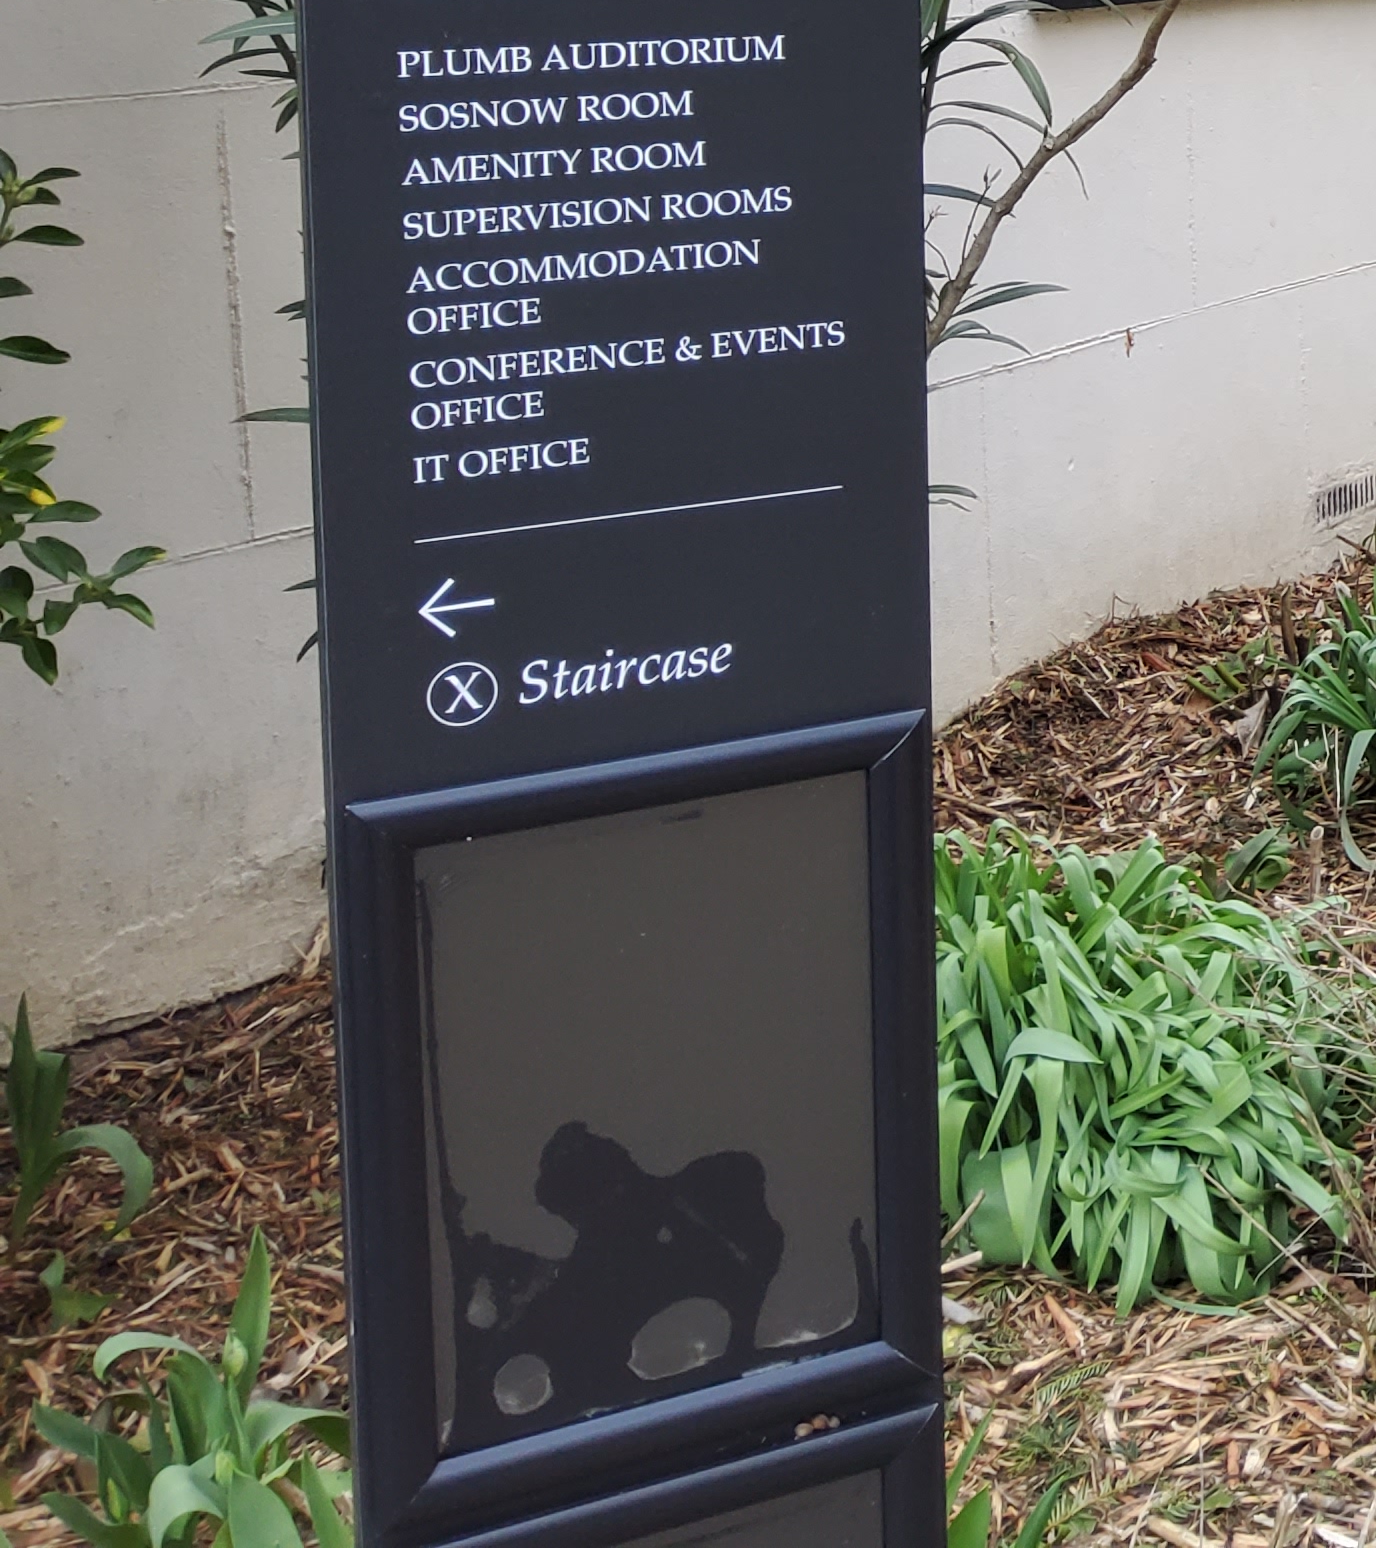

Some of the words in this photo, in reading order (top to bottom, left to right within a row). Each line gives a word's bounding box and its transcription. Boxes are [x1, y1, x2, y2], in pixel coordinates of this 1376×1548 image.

[395, 45, 534, 79] PLUMB
[539, 33, 787, 72] AUDITORIUM
[397, 95, 570, 133] SOSNOW
[575, 89, 695, 123] ROOM
[400, 147, 583, 187] AMENITY
[589, 139, 708, 175] ROOM
[401, 194, 653, 241] SUPERVISION
[660, 184, 794, 221] ROOMS
[405, 237, 762, 295] ACCOMMODATION
[405, 296, 543, 336] OFFICE
[408, 336, 667, 390] CONFERENCE
[674, 334, 704, 363] &
[709, 319, 847, 359] EVENTS
[409, 389, 546, 431] OFFICE
[411, 453, 451, 485] IT
[456, 436, 591, 479] OFFICE
[443, 669, 485, 715] X
[517, 642, 734, 706] Staircase
